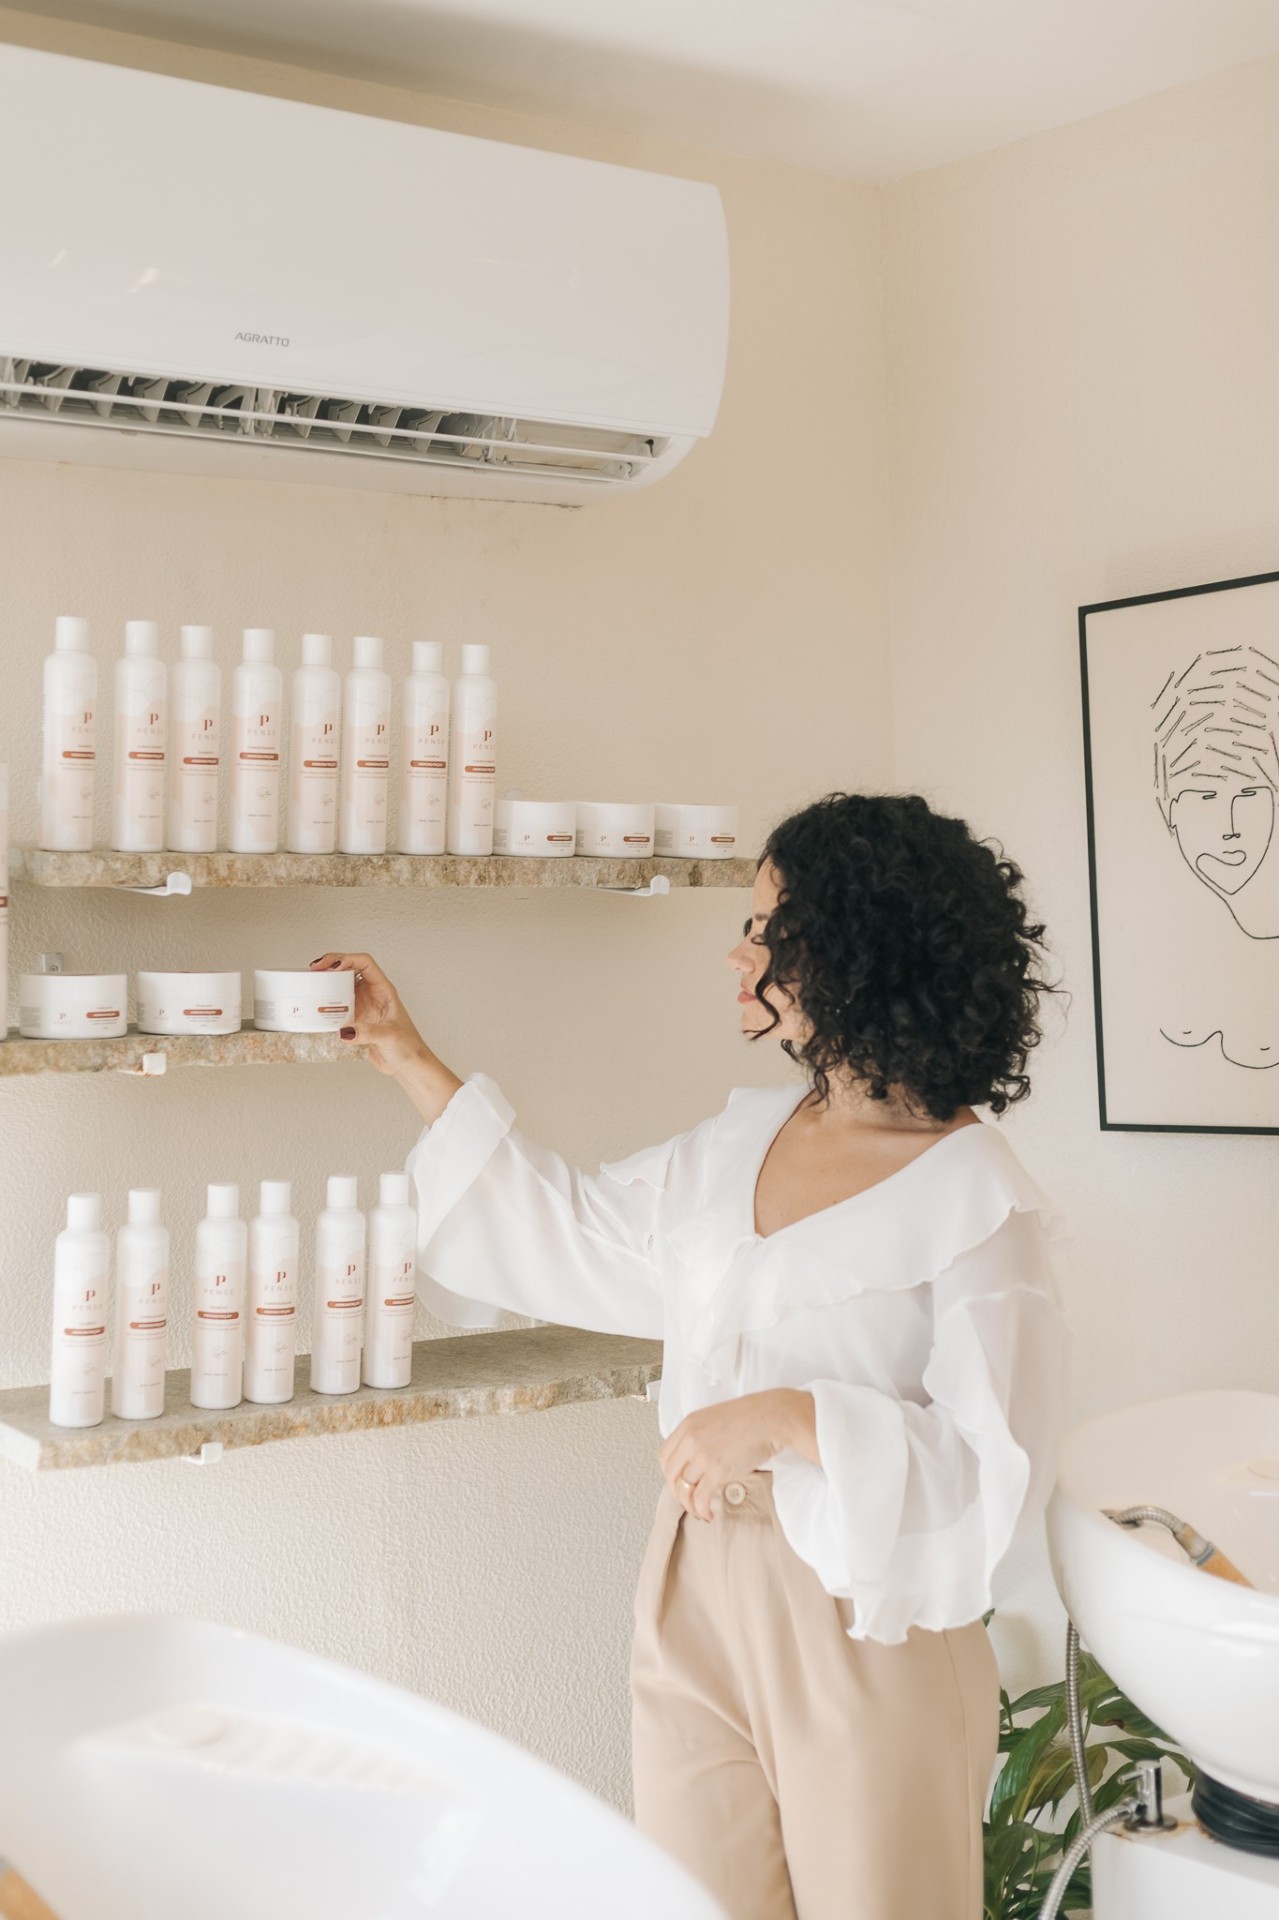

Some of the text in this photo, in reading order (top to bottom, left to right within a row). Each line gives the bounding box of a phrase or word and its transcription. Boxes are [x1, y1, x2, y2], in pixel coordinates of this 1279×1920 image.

[235, 331, 290, 347] AGRATTO
[83, 712, 93, 724] P
[149, 713, 159, 725] P
[260, 715, 270, 727] P
[203, 719, 213, 731] P
[323, 723, 333, 735] P
[376, 724, 386, 735] P
[430, 725, 439, 736] P
[484, 730, 493, 741] P
[347, 1264, 356, 1276] P
[404, 1262, 412, 1274] P
[216, 1275, 226, 1287] P
[277, 1271, 287, 1283] P
[151, 1283, 161, 1296] P
[86, 1290, 96, 1302] P
